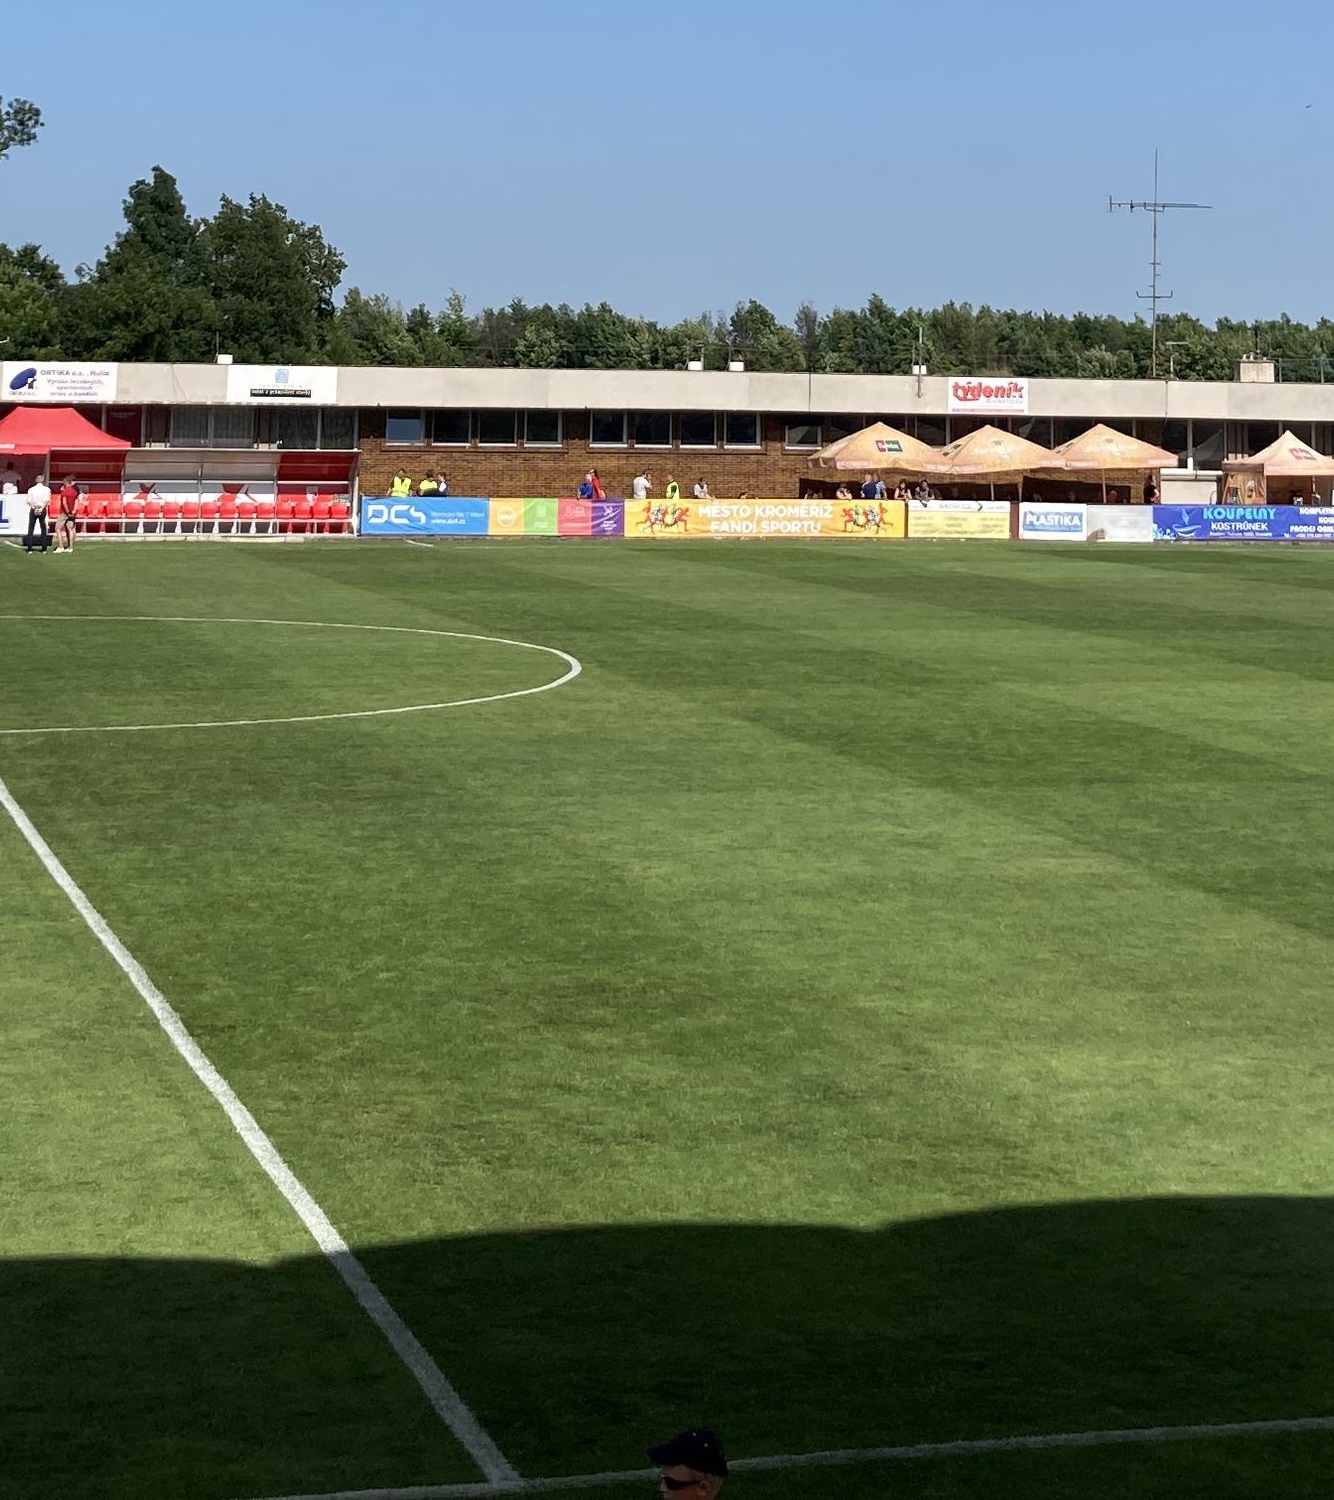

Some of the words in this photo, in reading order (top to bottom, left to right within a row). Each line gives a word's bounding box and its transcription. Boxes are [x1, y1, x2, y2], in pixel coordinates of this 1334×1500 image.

[698, 501, 751, 518] MĚSTO
[754, 500, 835, 518] KROMĚŘÍŽ
[1202, 507, 1277, 520] KOUPELNY
[710, 517, 757, 533] FANDÍ
[760, 520, 821, 533] SPORTU
[1026, 513, 1082, 526] PLASTIKA
[1211, 520, 1269, 531] KOSTRŮNEK
